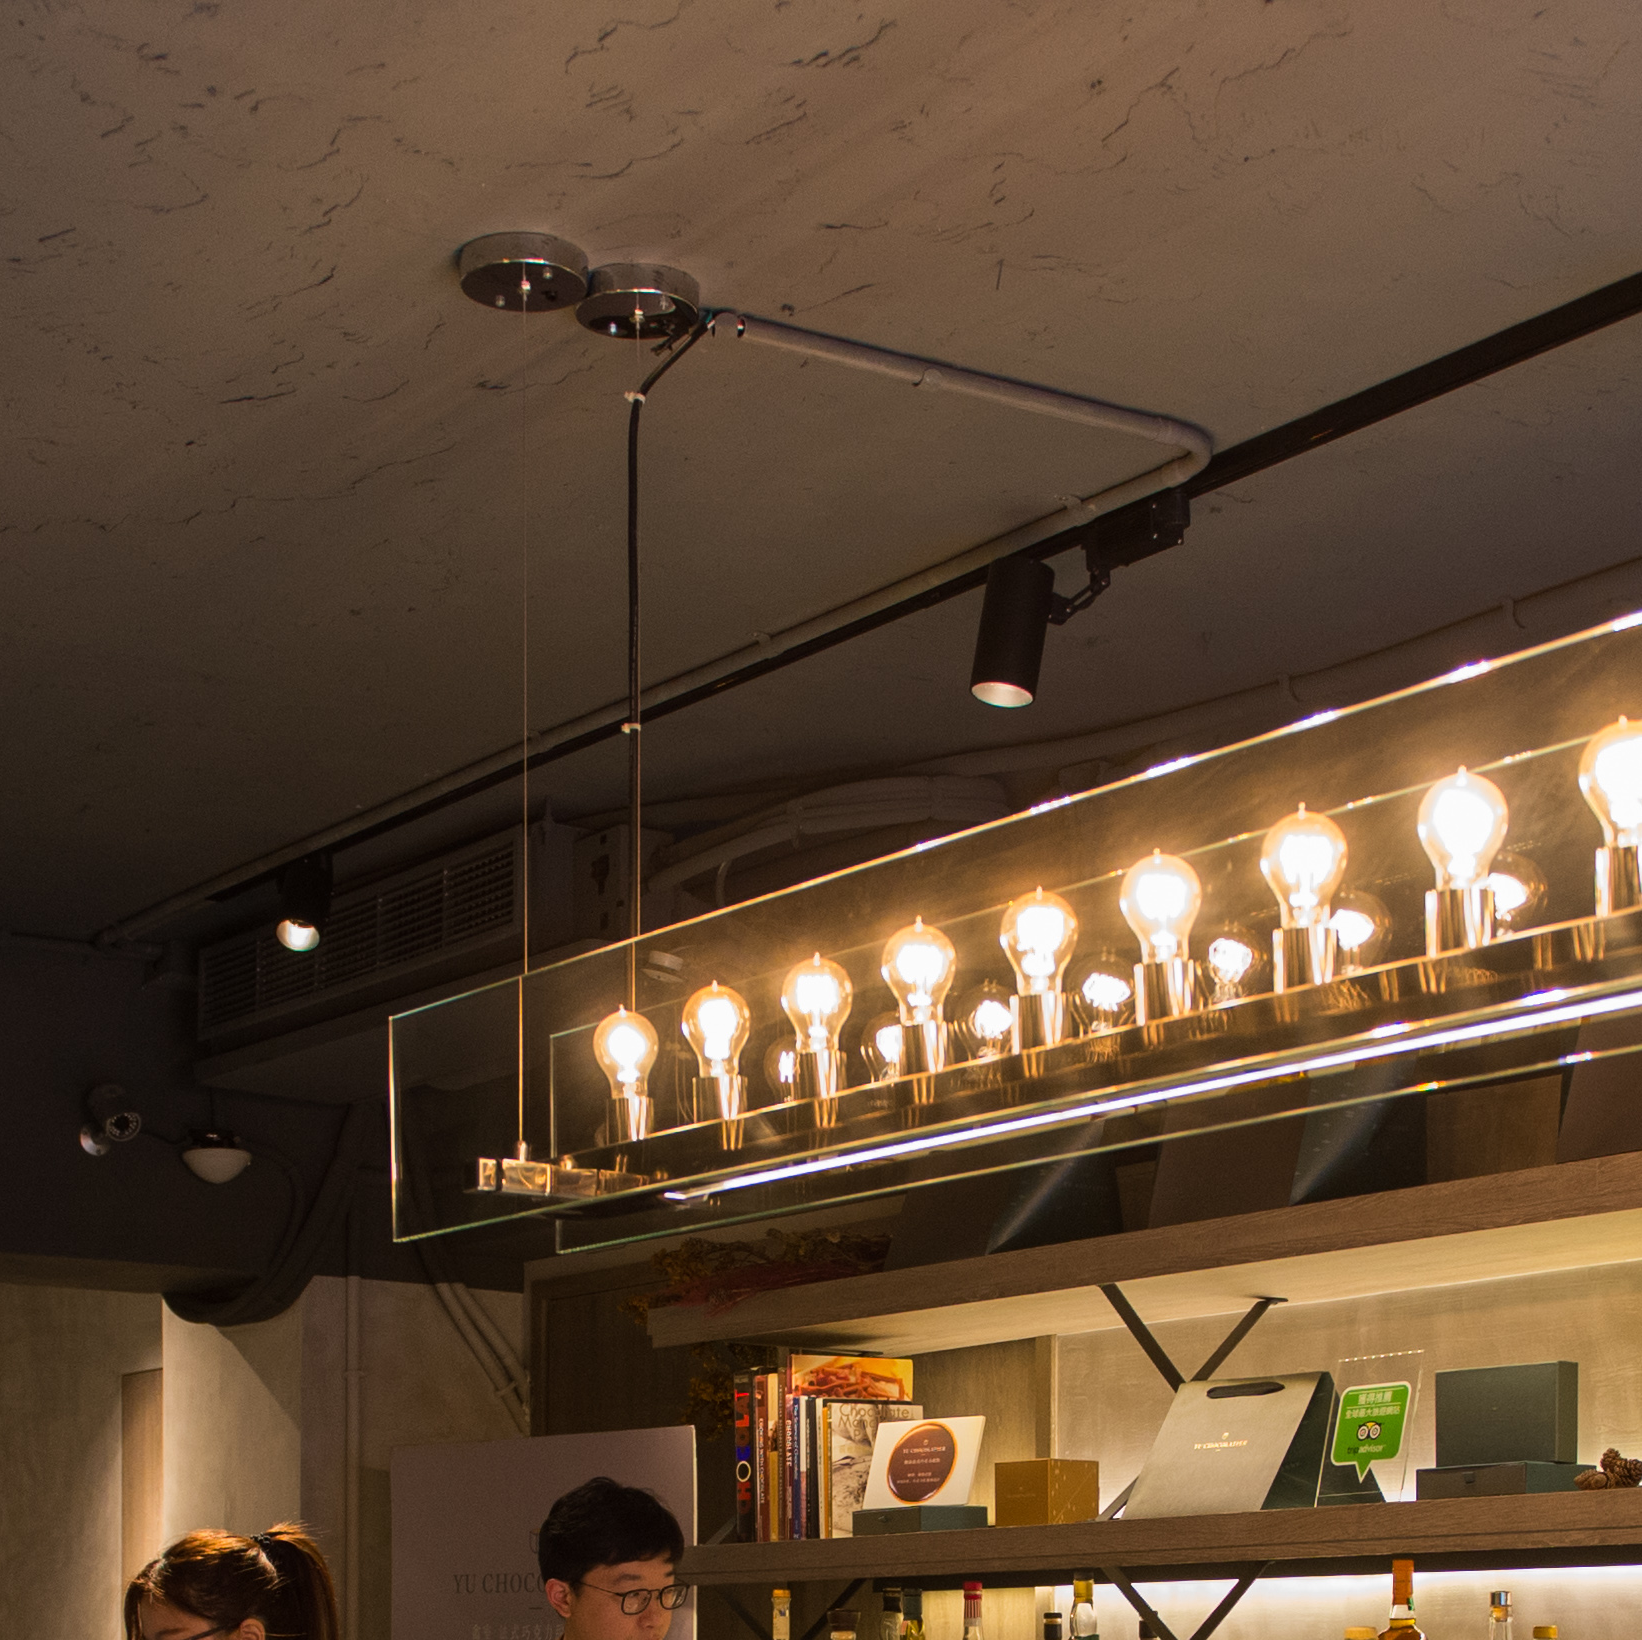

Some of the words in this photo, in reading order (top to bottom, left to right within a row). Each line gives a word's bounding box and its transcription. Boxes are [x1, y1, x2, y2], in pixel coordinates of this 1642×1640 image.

[785, 1420, 793, 1466] CHOCOLATE
[1347, 1444, 1385, 1455] tripadvisor
[453, 1574, 476, 1593] YU
